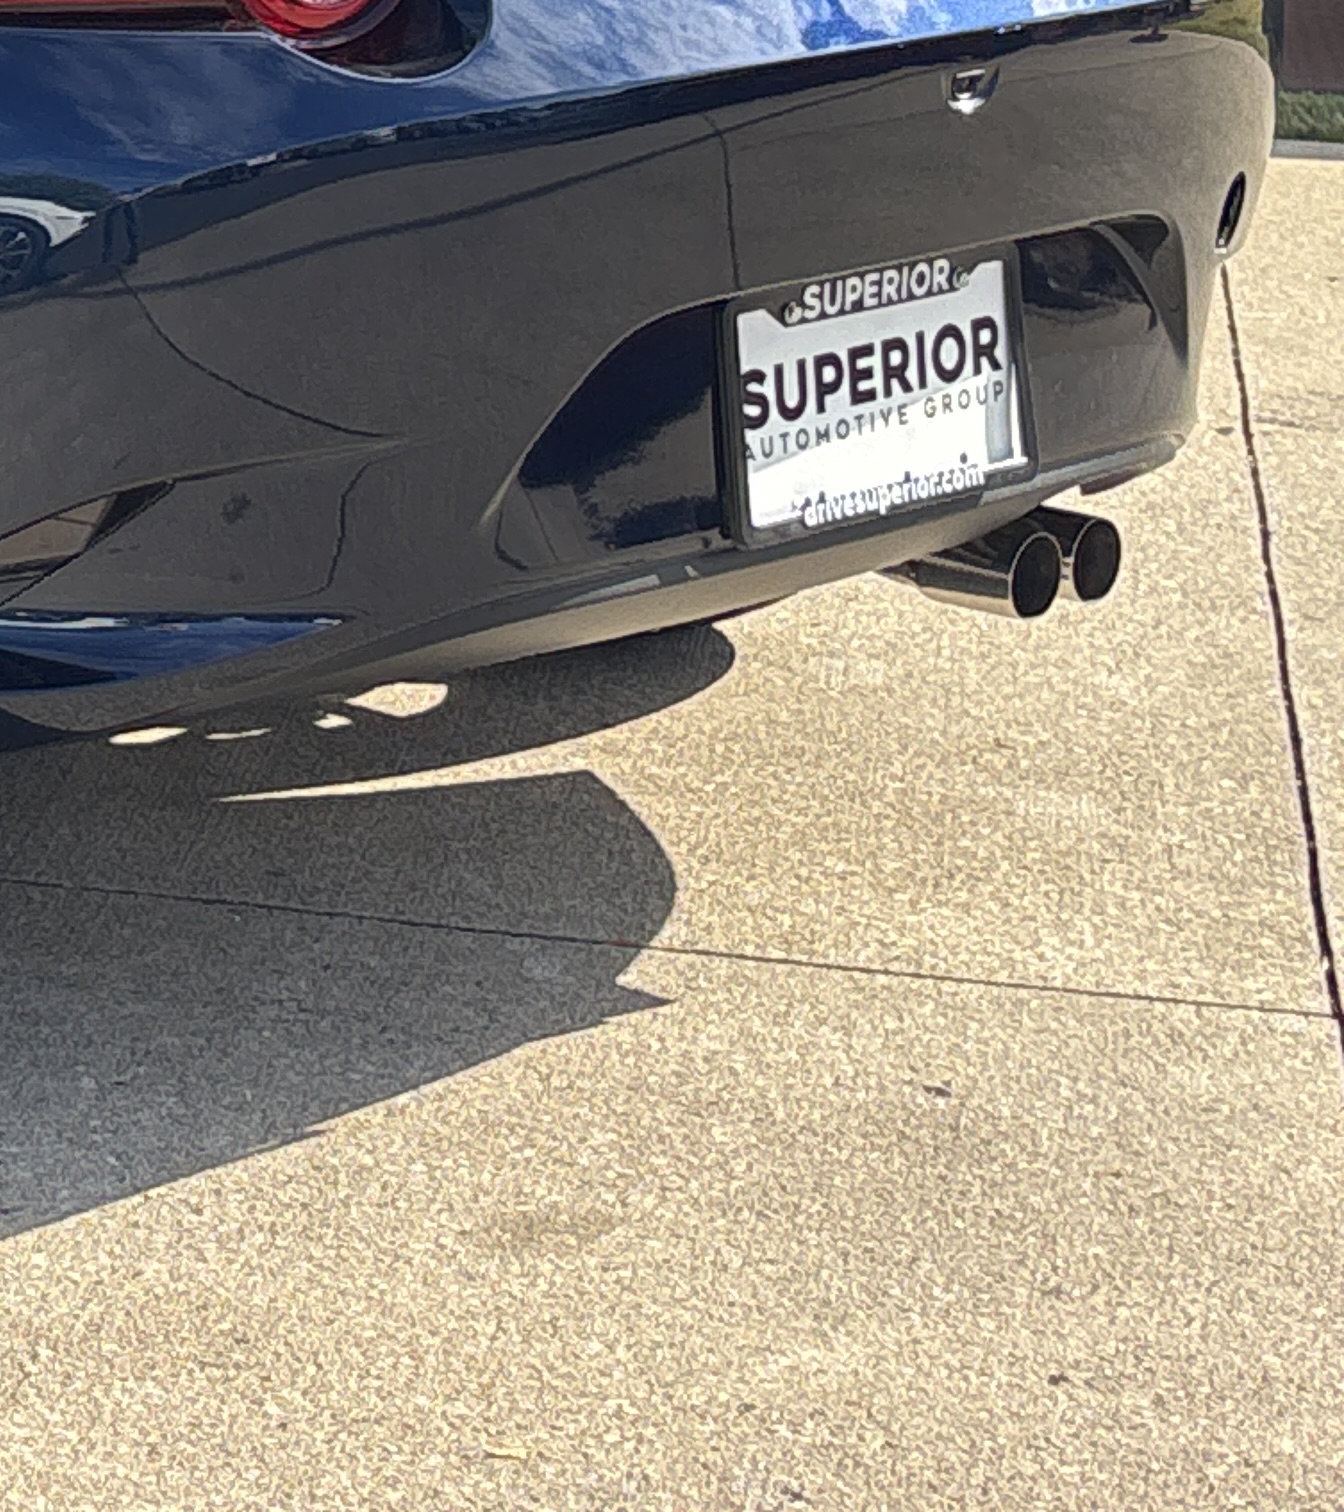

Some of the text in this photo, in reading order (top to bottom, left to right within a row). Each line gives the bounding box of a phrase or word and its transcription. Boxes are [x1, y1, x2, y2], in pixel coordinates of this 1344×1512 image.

[802, 258, 951, 321] SUPERIOR
[741, 315, 1003, 430] SUPERIOR
[744, 379, 1005, 462] AUTOMOTIVE GROUP
[803, 464, 986, 528] drivesuperior.com
